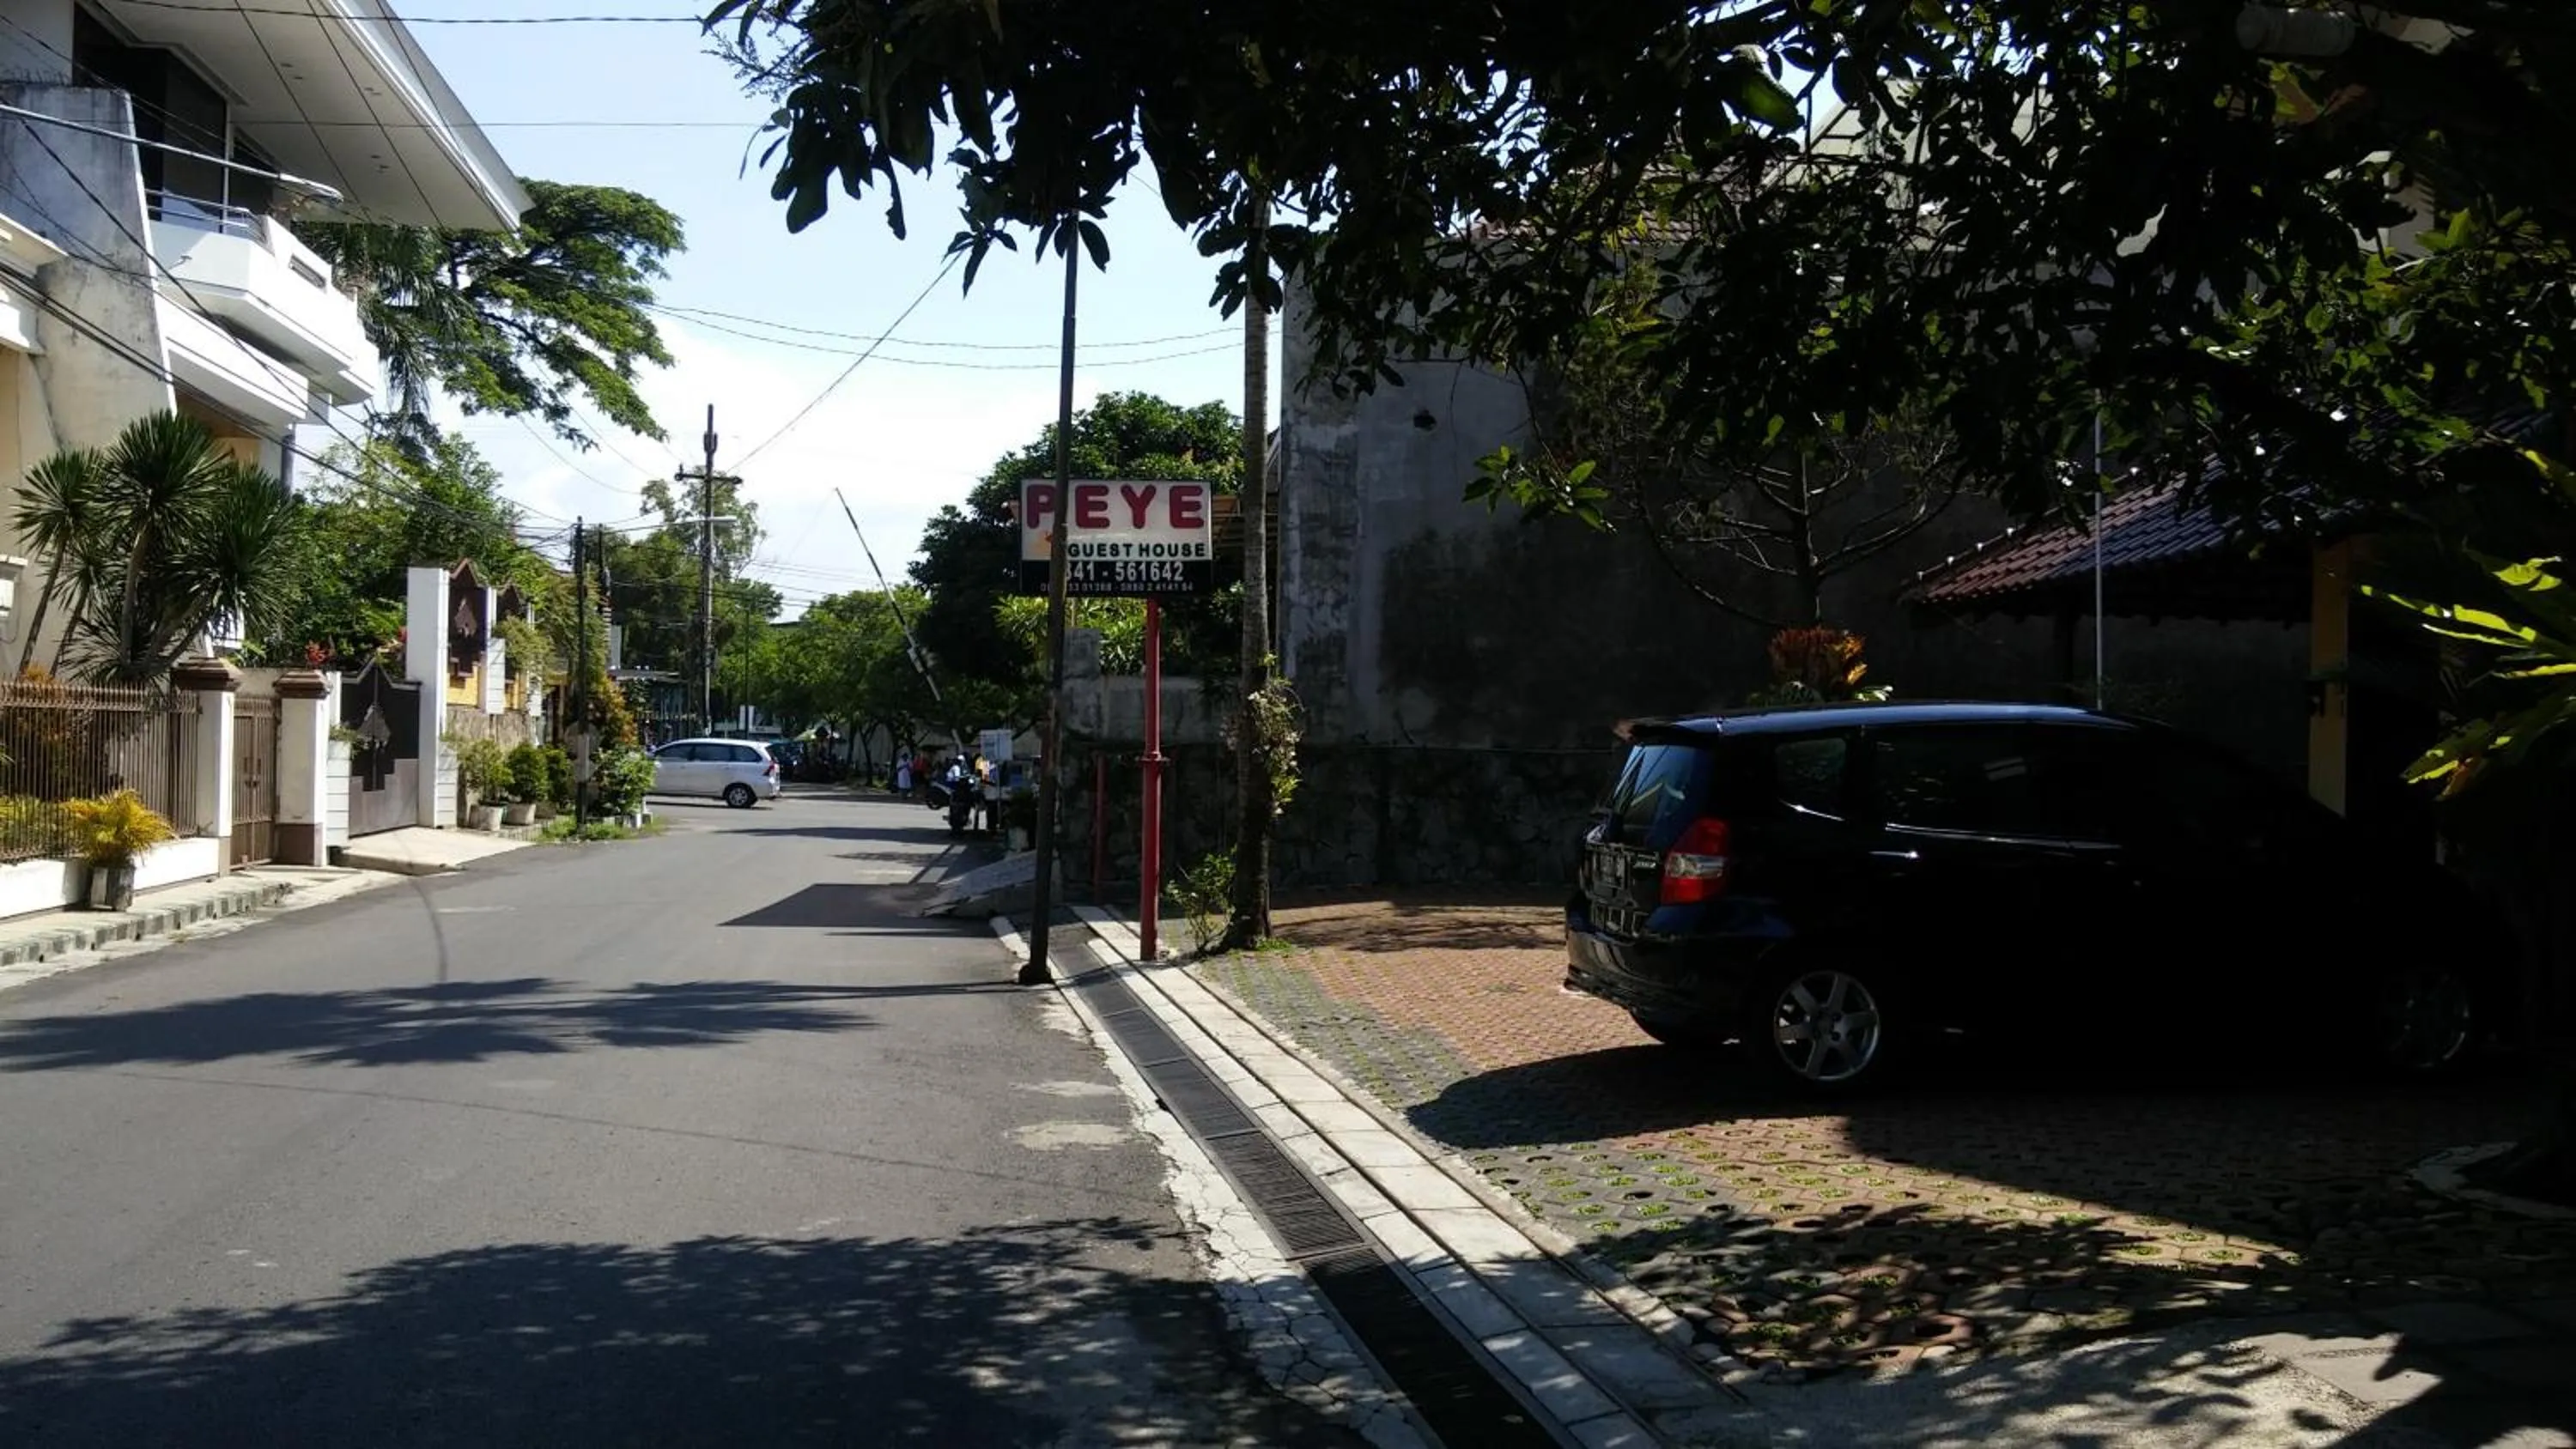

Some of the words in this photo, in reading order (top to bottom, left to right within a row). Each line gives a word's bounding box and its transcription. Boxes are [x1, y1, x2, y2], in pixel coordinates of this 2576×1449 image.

[1026, 483, 1205, 530] PEYE
[1067, 543, 1133, 558] GUEST
[1139, 543, 1206, 558] HOUSE
[1115, 561, 1184, 582] 561642
